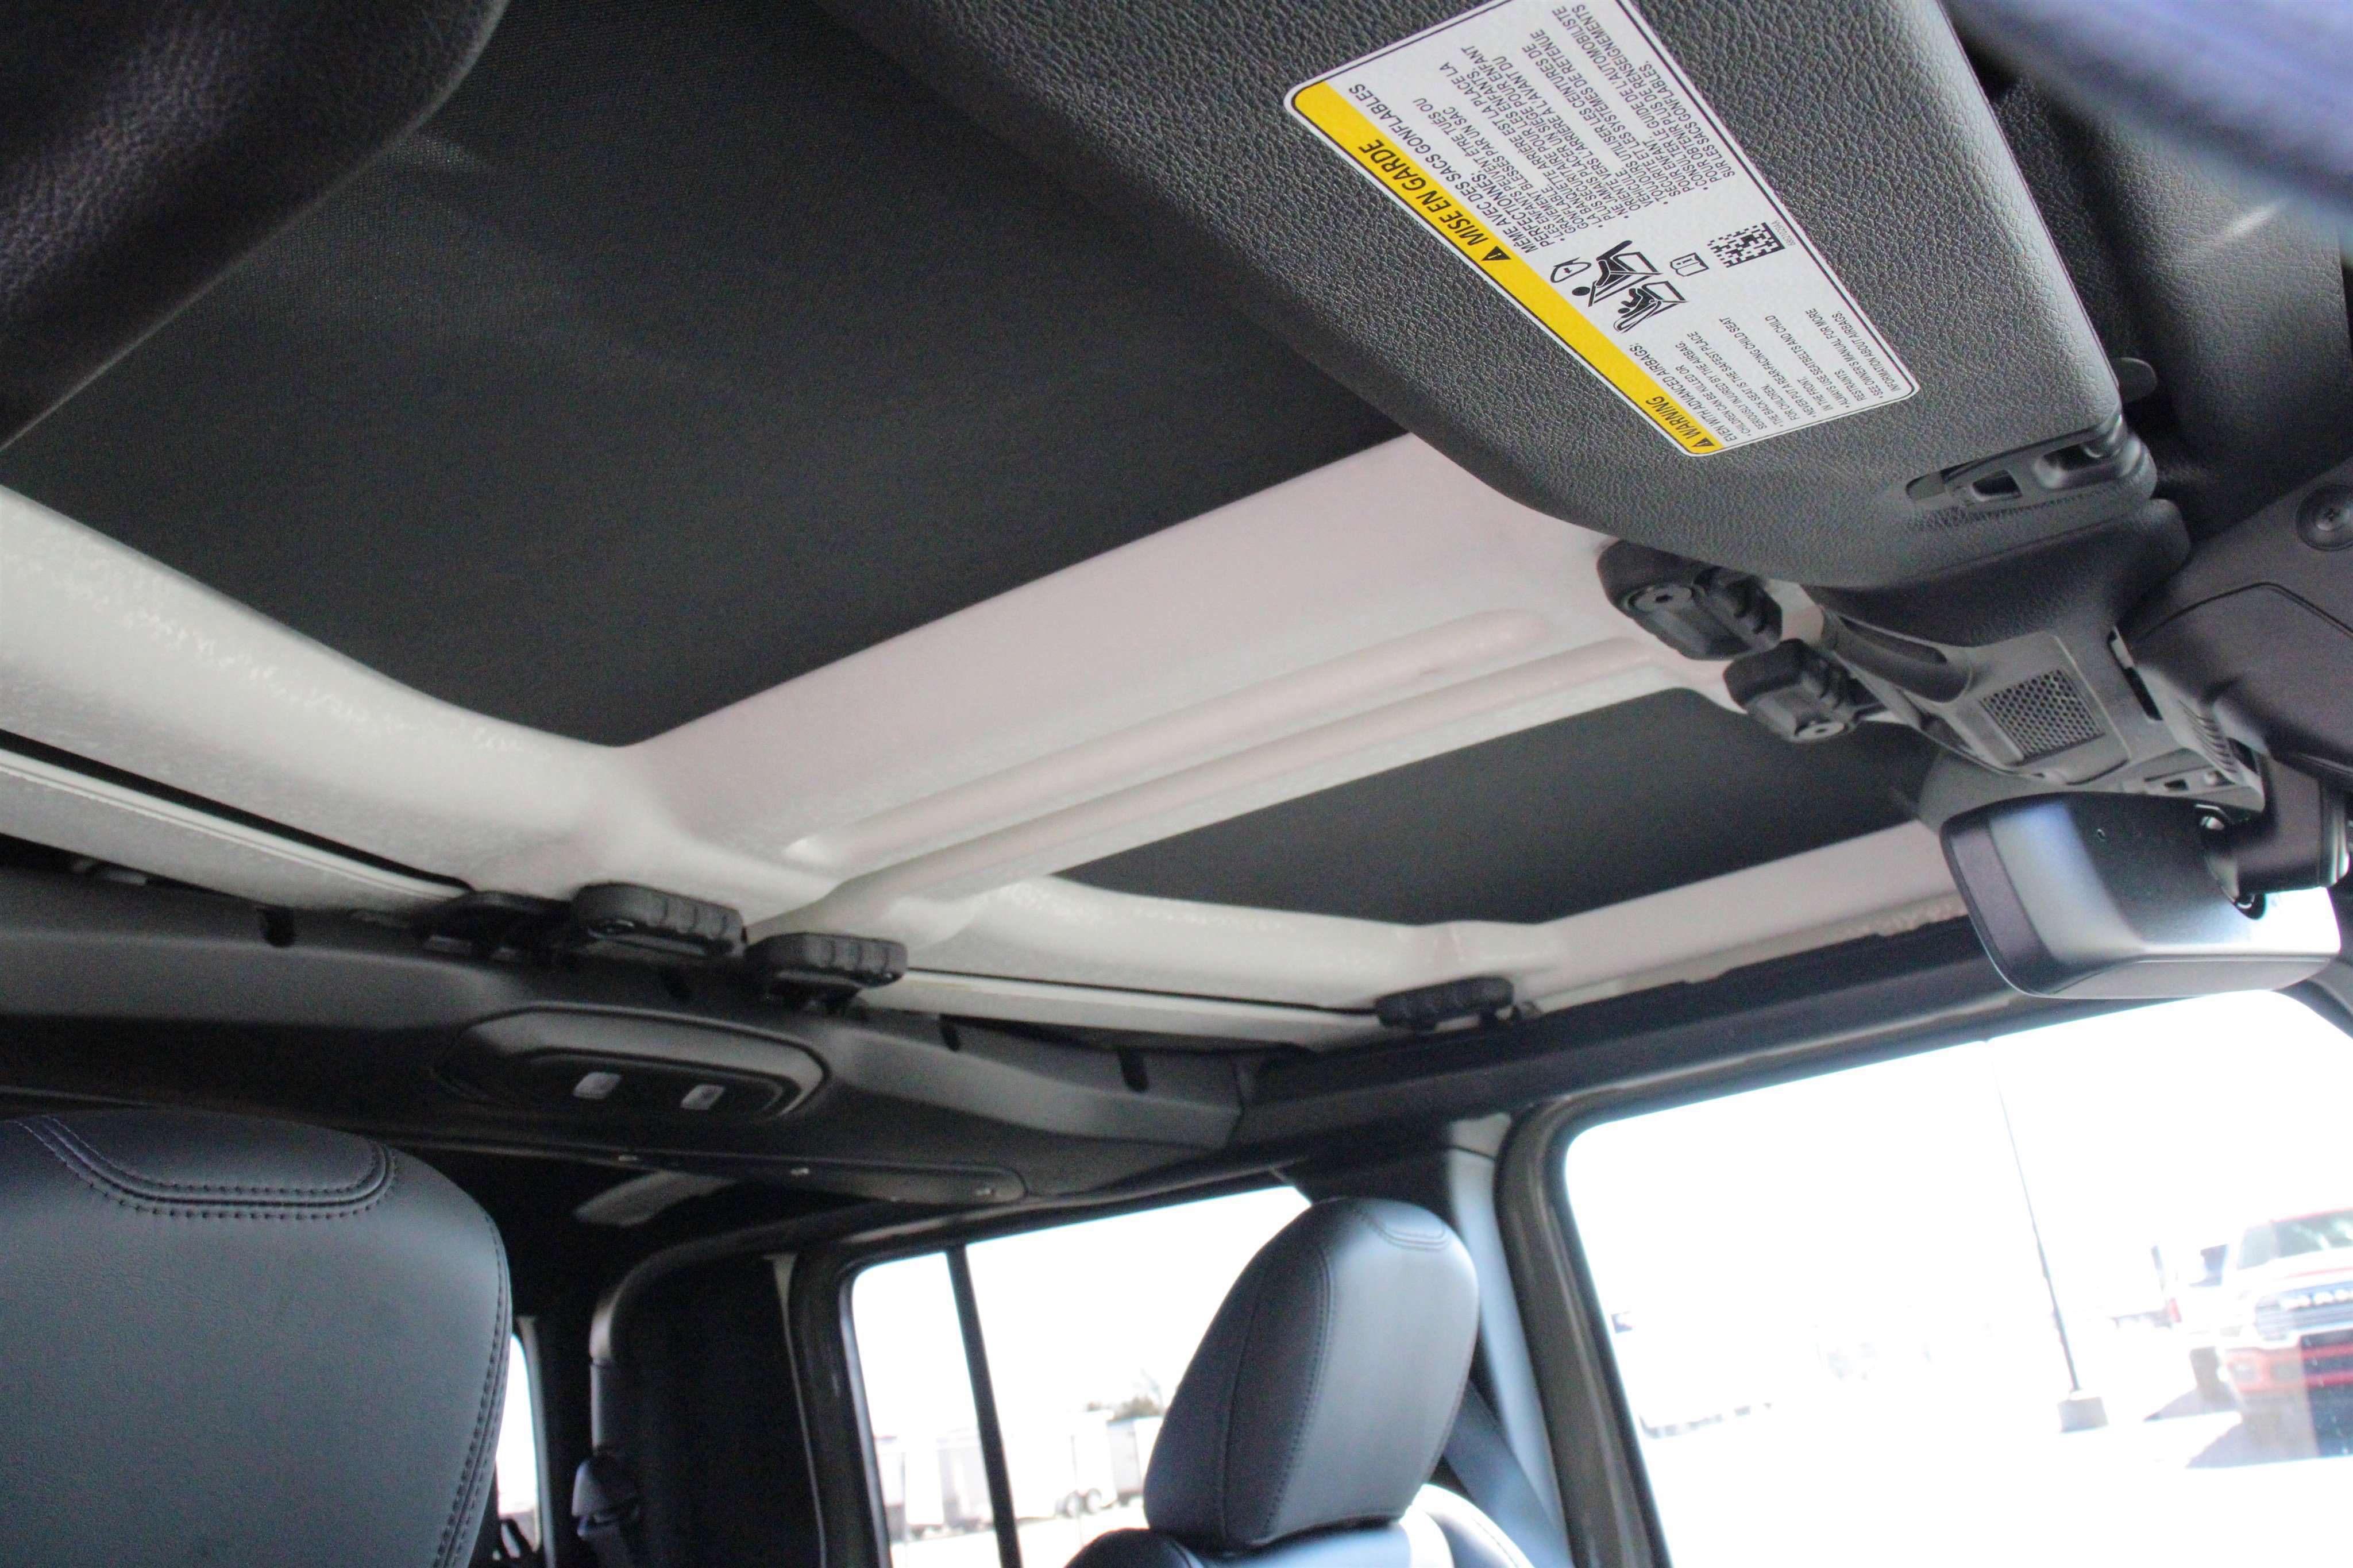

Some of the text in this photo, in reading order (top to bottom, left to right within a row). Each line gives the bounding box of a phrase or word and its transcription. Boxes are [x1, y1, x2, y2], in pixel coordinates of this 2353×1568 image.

[1491, 56, 1513, 71] DU
[1538, 106, 1555, 115] À
[1571, 4, 1722, 183] POUR OBTENIR PLUS DE RENSEIGNEMENTS
[1618, 87, 1639, 103] DE
[1460, 45, 1628, 215] NE JAMAIS PLACER UN SIÈGE POUR ENFANT
[1521, 43, 1667, 202] TOUJOURS UTILISER LES CEINTURES DE
[1529, 29, 1681, 197] SÉCURITÉ ET LES SYSTÈMES DE RETENUE
[1630, 101, 1660, 129] GUIDE
[1638, 60, 1735, 177] SUR LES SACS GONFLABLES.
[1438, 61, 1602, 225] LA BANQUETTE ARRIÈRE EST LA PLACE LA
[1465, 68, 1615, 221] PLUS SÉCURITAIRE POUR LES ENFANTS.
[1652, 128, 1670, 141] LE
[1348, 83, 1538, 253] MÊME AVEC DES SACS GONFLABLES
[1413, 97, 1564, 238] LES ENFANTS PEUVENT ÊTRE TUÉS OU
[1442, 106, 1576, 234] GRAVEMENT BLESSÉS PAR UN SAC
[1586, 157, 1611, 180] VERS
[1641, 136, 1695, 192] POUR ENFANT.
[1662, 139, 1707, 186] CONSULTER
[1357, 138, 1488, 246] MISE EN GARDE
[1604, 178, 1641, 211] ORIENTÉ
[1614, 167, 1654, 207] VÉHICULE.
[1471, 170, 1555, 247] PERFECTIONNÉS:
[1540, 184, 1589, 229] GONFLABLE.
[1718, 316, 1740, 333] SEAT
[1804, 308, 1827, 327] MORE
[1819, 325, 1837, 339] FOR
[1686, 331, 1712, 352] PLACE
[1733, 332, 1756, 349] CHILD
[1831, 338, 1856, 362] MANUAL
[1831, 310, 1901, 392] INFORMATION ABOUT AIRBAGS.
[1704, 350, 1732, 372] SAFEST
[1725, 370, 1742, 383] THE
[1749, 349, 1788, 385] REAR-FACING
[1764, 315, 1850, 405] ALWAYS USE SEATBELTS AND CHILD
[1629, 342, 1738, 442] EVEN WITH ADVANCED AIRBAGS:
[1675, 341, 1767, 430] SERIOUSLY INJURED BY THE AIRBAG.
[1675, 364, 1750, 434] CHILDREN CAN BE KILLED OR
[1741, 388, 1760, 401] SEAT
[1760, 383, 1800, 420] FOR CHILDREN.
[1784, 388, 1802, 399] PUT
[1796, 376, 1819, 396] FRONT.
[1812, 393, 1827, 405] THE
[1834, 368, 1867, 401] RESTRAINTS.
[1868, 384, 1883, 396] SEE
[1645, 396, 1701, 439] WARNING
[1754, 400, 1774, 415] BACK
[1767, 414, 1783, 425] THE
[1794, 397, 1816, 415] NEVER
